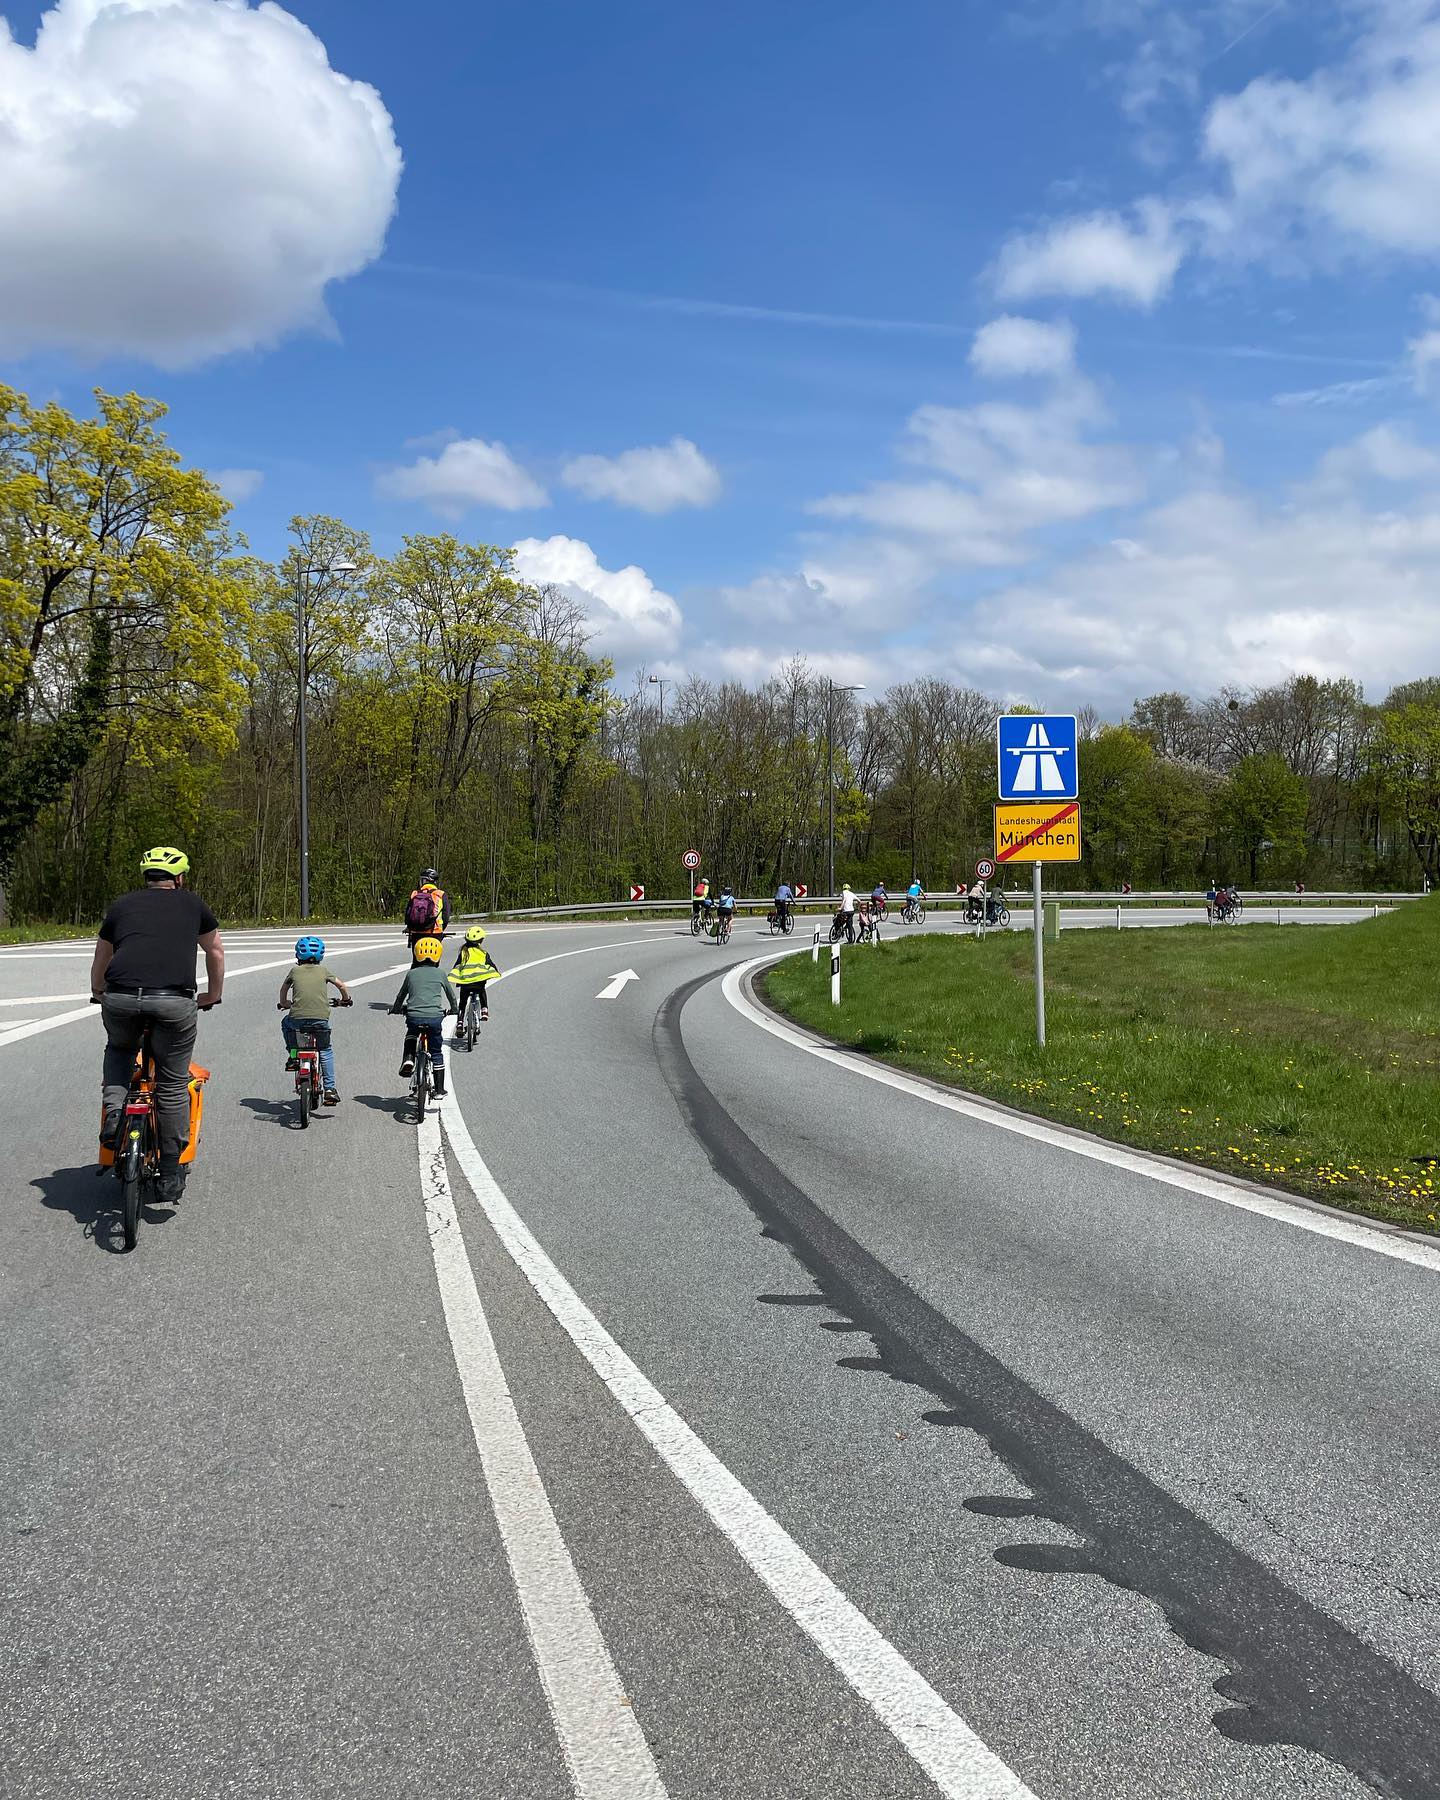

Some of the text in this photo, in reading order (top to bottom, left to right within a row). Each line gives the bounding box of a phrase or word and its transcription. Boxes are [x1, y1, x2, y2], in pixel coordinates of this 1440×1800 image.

[1000, 831, 1075, 846] München
[686, 855, 697, 864] 60
[980, 864, 990, 874] 60
